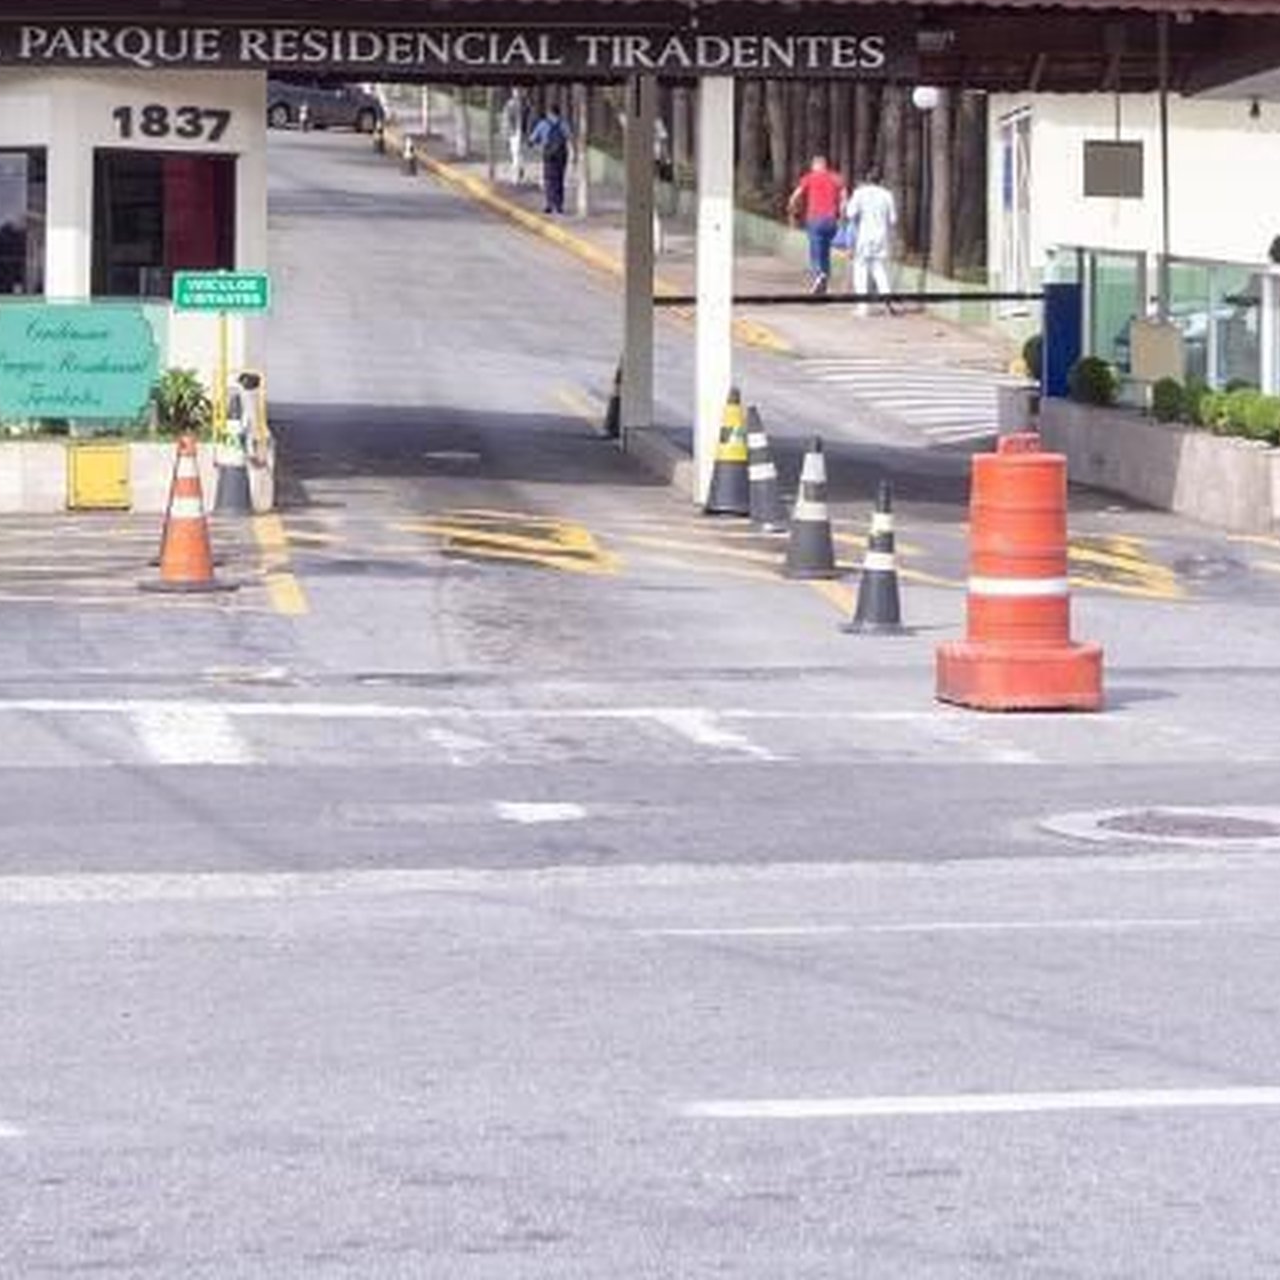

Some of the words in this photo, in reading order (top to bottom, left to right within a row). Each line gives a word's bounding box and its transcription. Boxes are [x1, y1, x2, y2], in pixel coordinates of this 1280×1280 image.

[19, 26, 220, 67] PARQUE
[238, 29, 562, 66] RESIDENCIAL
[577, 34, 886, 68] TIRADENTES
[112, 105, 232, 142] 1837
